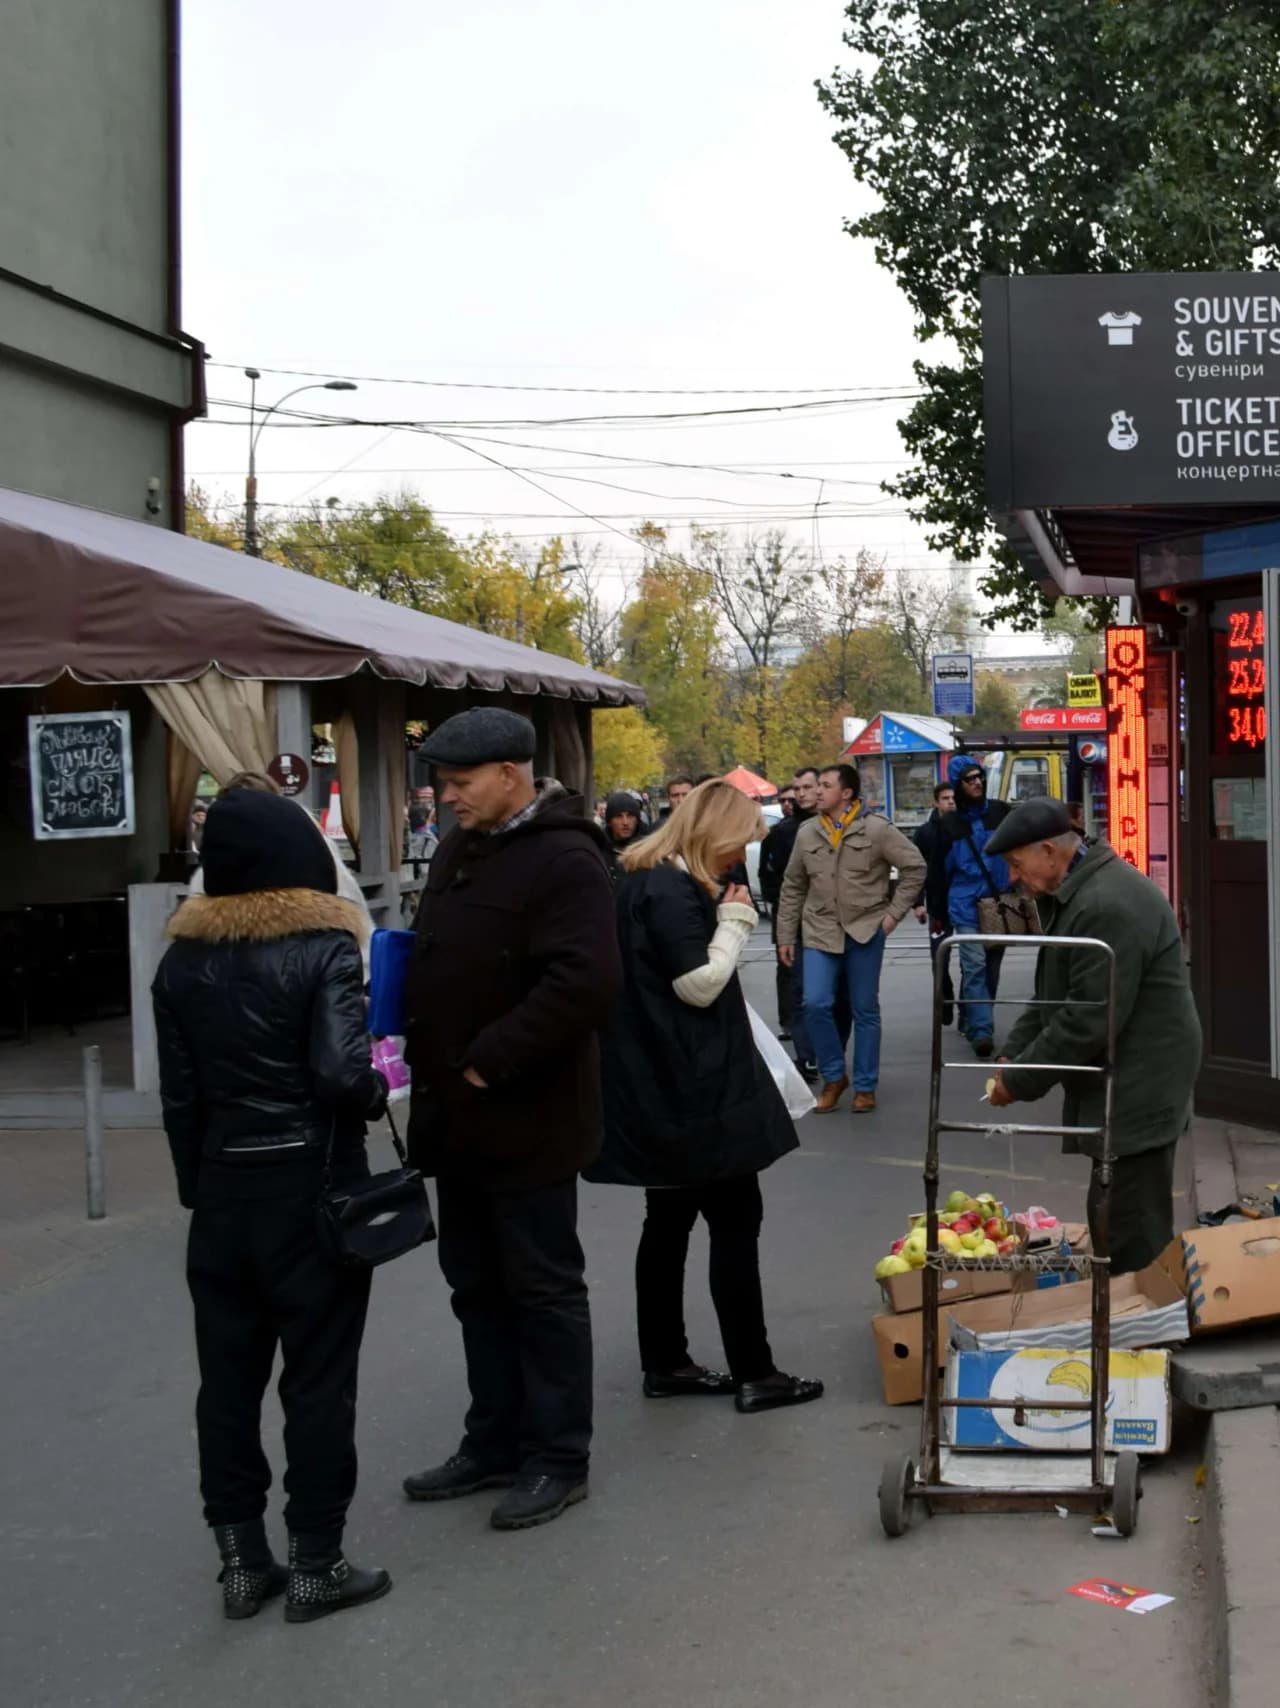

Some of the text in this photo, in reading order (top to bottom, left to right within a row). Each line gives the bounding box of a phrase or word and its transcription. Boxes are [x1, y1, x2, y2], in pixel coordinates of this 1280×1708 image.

[1175, 330, 1194, 356] &
[1175, 360, 1264, 381] сувеніри
[1176, 397, 1280, 426] TICKET
[1176, 430, 1280, 458] OFFICE
